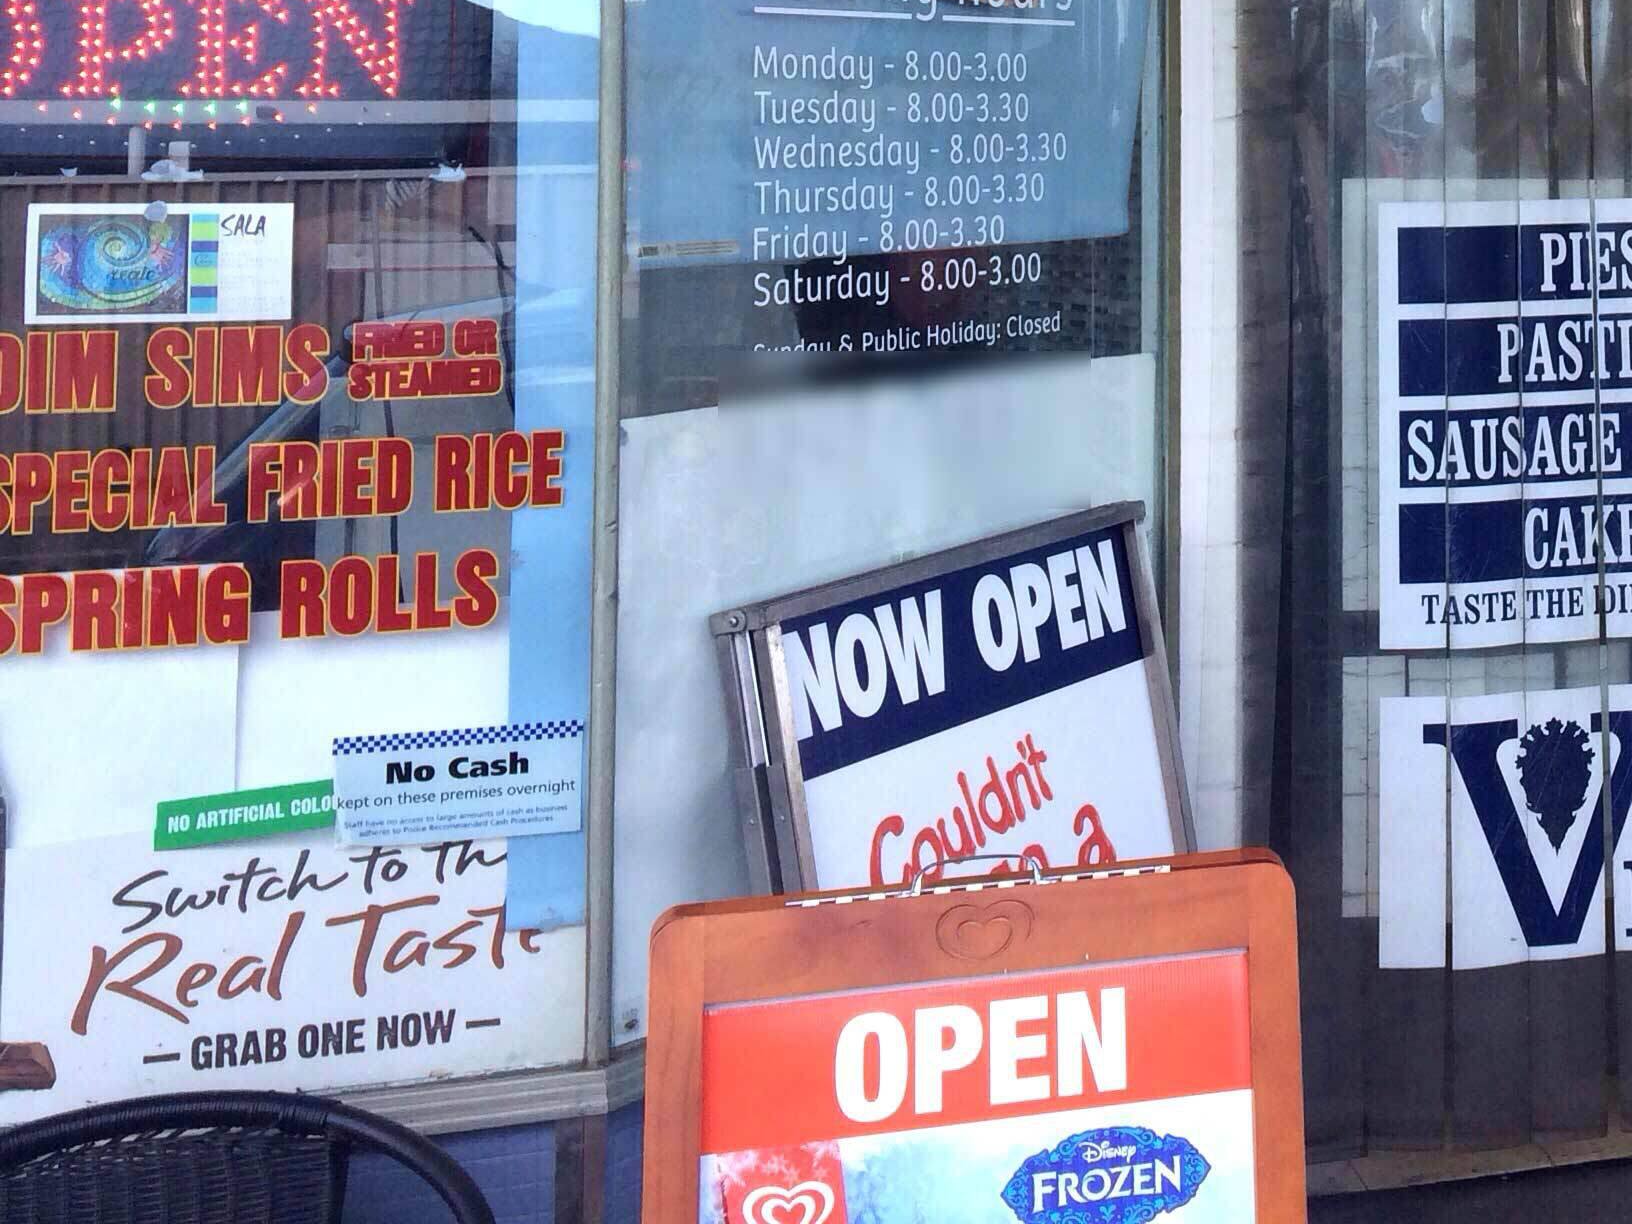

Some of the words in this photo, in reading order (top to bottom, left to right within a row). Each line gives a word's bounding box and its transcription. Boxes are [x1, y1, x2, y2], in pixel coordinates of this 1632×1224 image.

[753, 45, 874, 89] Monday
[905, 50, 1027, 82] 8.00-3.00
[754, 91, 877, 132] Tuesday
[907, 93, 1029, 123] 8.00-3.30
[754, 133, 920, 173] Wednesday
[949, 133, 1067, 164] 8.00-3.30
[754, 177, 894, 218] Thursday
[924, 173, 1045, 208] 8.00-3.30
[220, 213, 267, 238] SALA
[753, 221, 848, 264] Friday
[879, 216, 1004, 253] 8.00-3.30
[753, 265, 890, 307] Saturday
[920, 252, 1041, 292] 8.00-3.00
[352, 320, 447, 363] FRIED
[452, 318, 500, 359] OR
[862, 327, 920, 352] Public
[927, 320, 1001, 346] Holiday:
[1007, 310, 1061, 337] Closed
[144, 322, 331, 410] SIMS
[347, 358, 504, 402] STEAMED
[1406, 412, 1622, 481] SAUSAGE
[0, 445, 228, 536] PECIAL
[247, 436, 415, 523] FRIED
[433, 429, 565, 514] RICE
[279, 548, 499, 640] ROLLS
[1422, 589, 1517, 625] TASTE
[1526, 587, 1584, 621] THE
[783, 589, 946, 741] NOW
[972, 539, 1127, 672] OPEN
[386, 760, 436, 785] No
[448, 751, 530, 780] Cash
[168, 813, 191, 834] NO
[196, 801, 285, 830] ARTIFICIAL
[336, 794, 370, 811] kept
[373, 796, 393, 808] on
[397, 789, 436, 805] these
[440, 784, 504, 803] premises
[507, 780, 576, 797] overnight
[869, 732, 1054, 887] Couldn't
[112, 848, 348, 934] Switch
[349, 845, 409, 894] to
[71, 911, 306, 1036] Real
[191, 1028, 287, 1071] GRAB
[297, 1016, 365, 1060] ONE
[377, 1008, 456, 1051] NOW
[835, 987, 1128, 1124] OPEN
[1079, 1140, 1137, 1164] Disney
[1031, 1155, 1182, 1212] FROZEN
